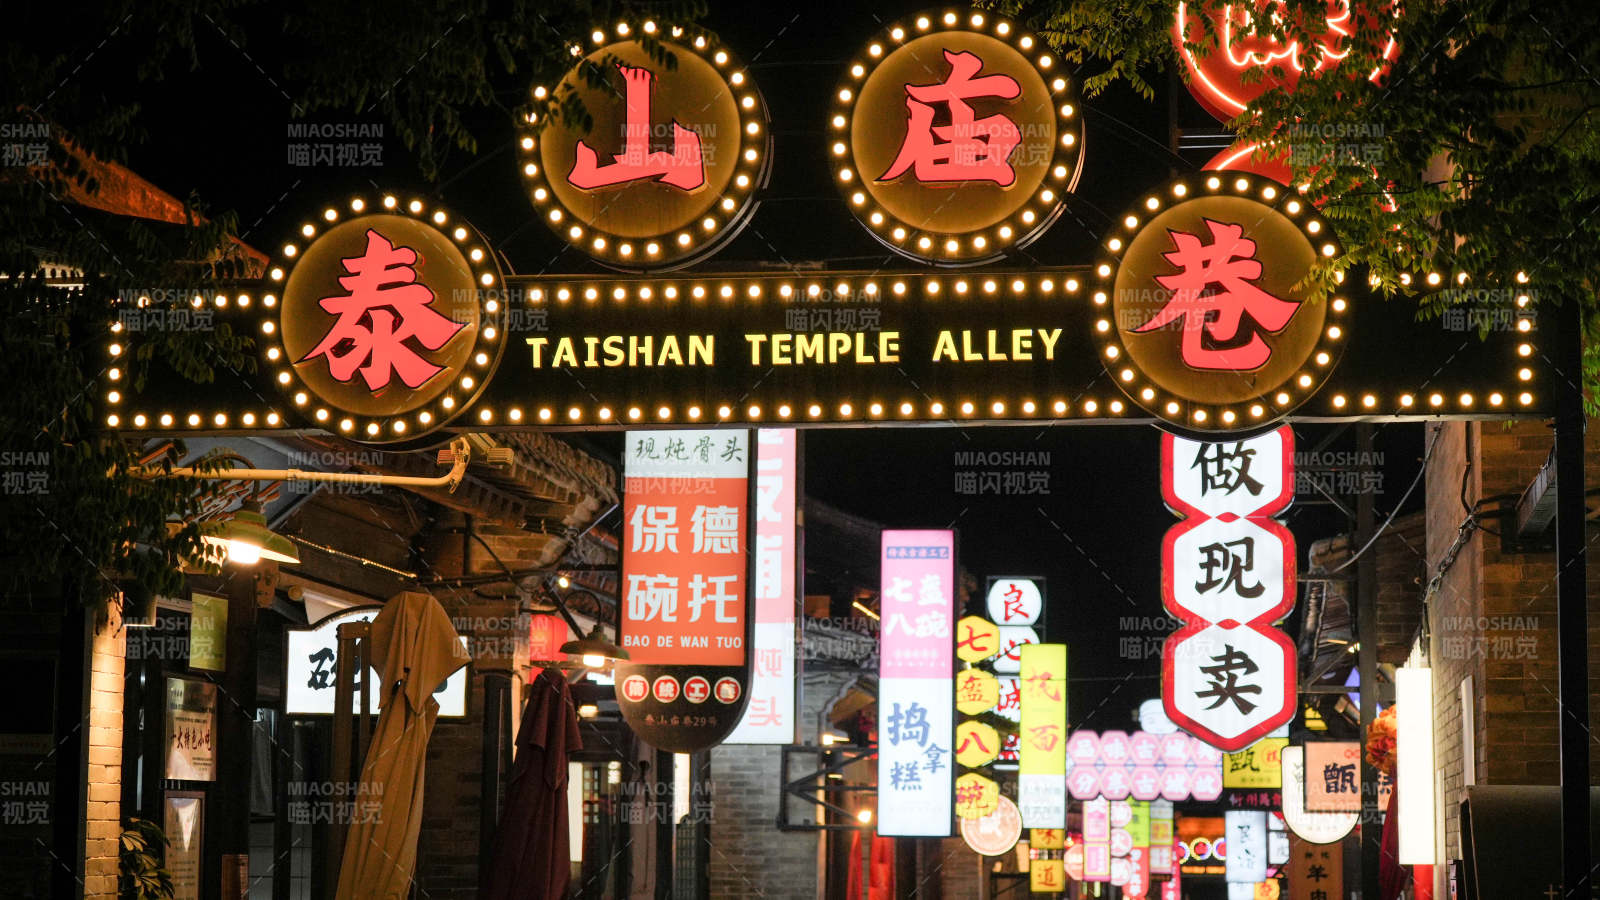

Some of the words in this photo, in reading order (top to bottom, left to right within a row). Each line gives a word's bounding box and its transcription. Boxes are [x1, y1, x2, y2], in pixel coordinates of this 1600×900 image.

[526, 335, 715, 368] TAISHAN
[744, 332, 900, 366] TEMPLE
[931, 328, 1063, 362] ALLEY
[635, 436, 743, 463] 现炖骨头
[630, 504, 739, 554] 保德
[626, 573, 738, 623] 碗托
[624, 635, 650, 647] BAO
[657, 636, 673, 647] DE
[680, 636, 709, 648] WAN
[716, 636, 742, 648] TUO
